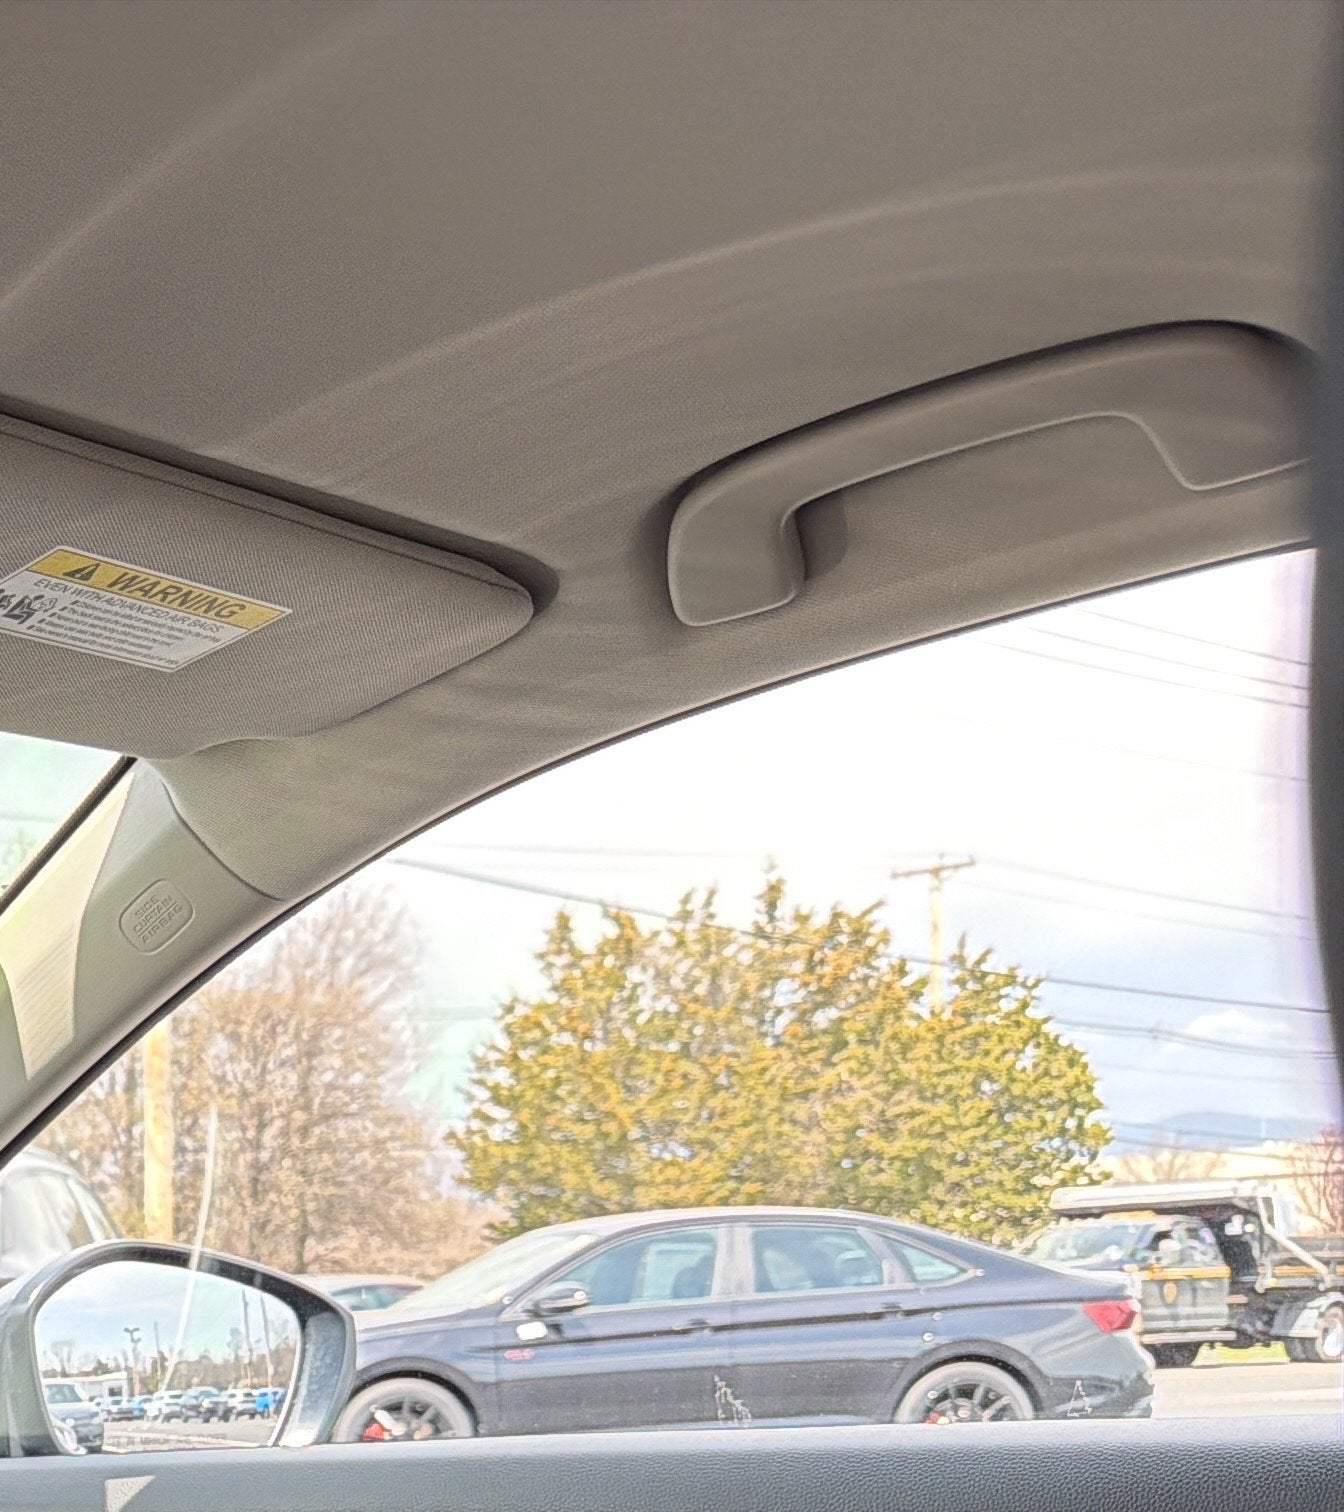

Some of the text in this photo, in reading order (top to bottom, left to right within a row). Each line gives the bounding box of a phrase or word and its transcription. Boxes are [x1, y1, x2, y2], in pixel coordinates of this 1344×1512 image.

[33, 579, 73, 595] EVEN
[68, 588, 107, 602] WITH
[98, 596, 173, 619] ADVANCED
[185, 619, 227, 633] BAGS
[107, 572, 247, 619] WARNING
[133, 896, 175, 933] CURTAIN
[134, 895, 160, 919] SIDE
